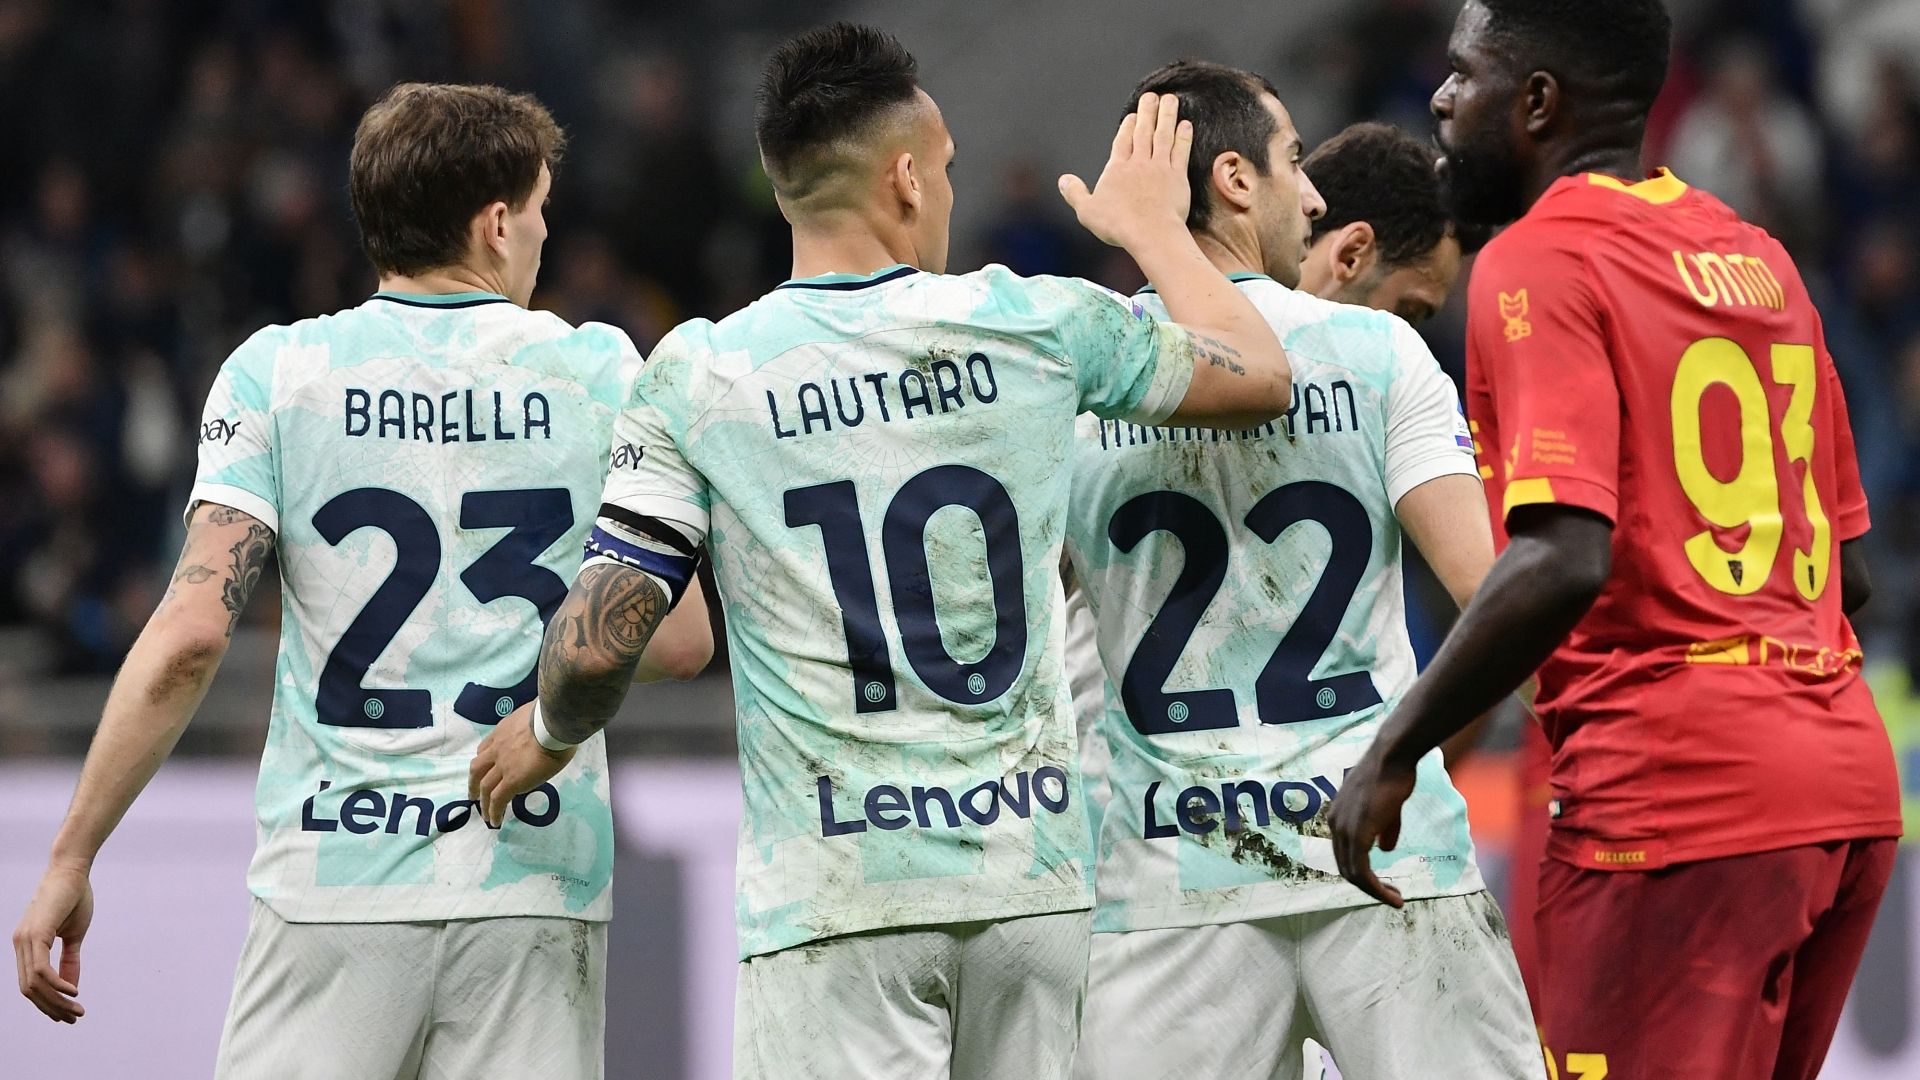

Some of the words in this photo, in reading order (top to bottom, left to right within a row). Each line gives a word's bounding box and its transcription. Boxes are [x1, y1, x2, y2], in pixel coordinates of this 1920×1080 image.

[346, 389, 550, 443] BARELLA
[767, 353, 998, 439] LAUTARO
[608, 443, 647, 473] ay
[1671, 337, 1831, 601] 93
[312, 487, 575, 729] 23
[783, 465, 1027, 714] 10
[1108, 481, 1384, 735] 22
[301, 781, 561, 837] Lenoo
[817, 766, 1069, 838] Lenovo
[1144, 767, 1358, 840] Leno
